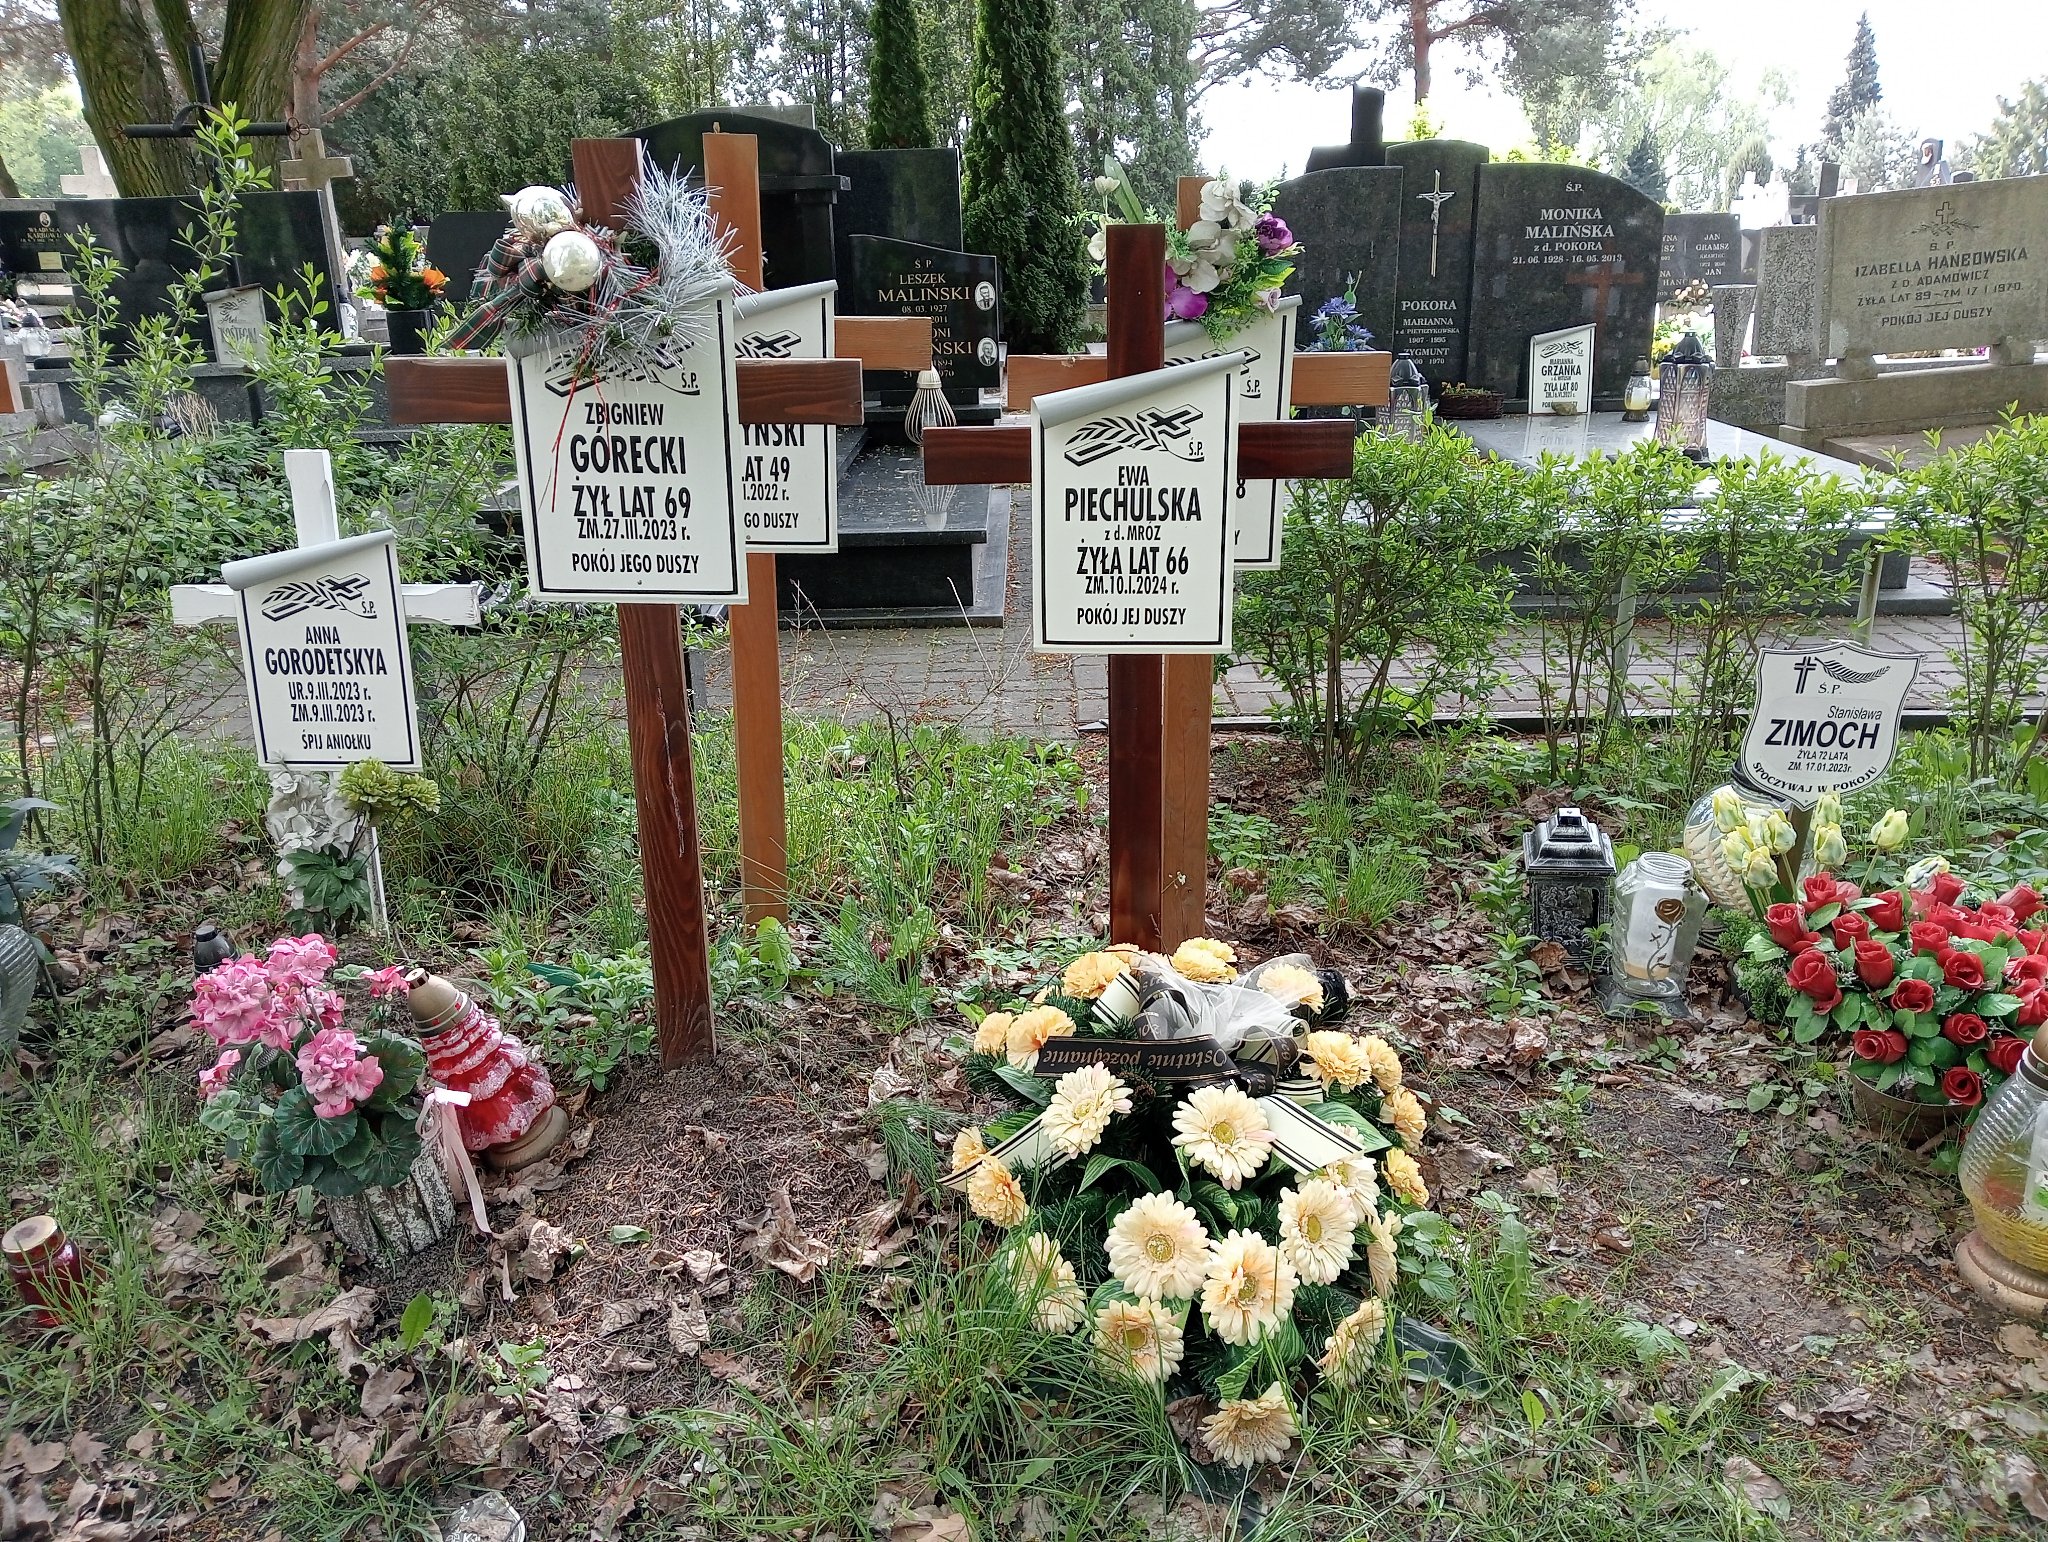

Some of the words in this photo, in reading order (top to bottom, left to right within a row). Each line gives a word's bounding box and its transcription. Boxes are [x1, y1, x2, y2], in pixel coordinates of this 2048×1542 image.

[1566, 182, 1583, 192] Ś.P.
[1540, 207, 1603, 220] MONIKA
[1525, 222, 1615, 239] MALIŃSKA
[1542, 243, 1552, 252] d.
[1555, 242, 1603, 251] POKORA
[1661, 244, 1675, 252] SZ
[1695, 243, 1730, 251] GRAMSZ
[1512, 256, 1525, 264] 21.
[1601, 253, 1622, 262] 2013
[1705, 268, 1722, 276] JAN
[1856, 260, 1921, 277] IZABELLA
[900, 273, 946, 284] LESZEK
[1917, 270, 1989, 287] ADAMOWICZ
[878, 283, 970, 302] MALIŃSKI
[1892, 293, 1911, 303] LAT
[1916, 291, 1932, 300] 89
[930, 304, 948, 313] 1927
[1401, 300, 1457, 311] POKORA
[1403, 317, 1454, 326] MARIANNA
[1927, 312, 1949, 323] JEJ
[1954, 307, 1992, 320] DUSZY
[1403, 348, 1450, 356] ZYGMUNT
[681, 367, 699, 389] Ś.P.
[1541, 365, 1581, 376] GRZANKA
[1246, 376, 1261, 393] Ś.P.
[1560, 382, 1569, 391] LAT
[1571, 382, 1579, 391] 80
[585, 403, 664, 426] ZBIGNIEW
[570, 426, 687, 475] GÓRECKI
[1188, 437, 1204, 456] Ś.P.
[742, 456, 763, 482] AT
[770, 456, 790, 482] 49
[1118, 466, 1150, 486] EWA
[572, 475, 614, 517] ŻYŁ
[619, 486, 655, 518] LAT
[664, 486, 691, 519] 69
[782, 488, 790, 501] r.
[1065, 488, 1202, 522] PIECHULSKA
[577, 518, 677, 540] ZM.27.III.2023
[681, 526, 691, 540] r.
[763, 512, 799, 529] DUSZY
[1105, 530, 1111, 541] z
[1127, 521, 1161, 541] MRÓZ
[572, 548, 615, 572] POKÓJ
[620, 554, 652, 573] JEGO
[656, 554, 699, 574] DUSZY
[1076, 538, 1123, 575] ŻYŁA
[1129, 547, 1160, 575] LAT
[1166, 546, 1189, 575] 66
[1085, 576, 1167, 595] ZM.10.I.2024
[1171, 581, 1179, 595] r.
[361, 597, 376, 614] Ś.P.
[1077, 603, 1118, 625] POKÓJ
[1122, 608, 1140, 625] JEJ
[1144, 608, 1186, 625] DUSZY
[305, 626, 341, 645] ANNA
[265, 648, 388, 676] GORODETSKYA
[288, 682, 361, 701] UR.9.III.2023
[363, 686, 372, 701] r.
[1818, 682, 1842, 694] Ś.P.
[291, 704, 365, 723] ZM.9.III.2023
[367, 708, 376, 723] r.
[1827, 705, 1883, 720] Stanisława
[302, 730, 322, 750] ŚPIJ
[326, 734, 372, 750] ANIOŁKU
[1764, 719, 1881, 750] ZIMOCH
[1797, 748, 1817, 760] ŻYŁA
[1819, 751, 1828, 760] 72
[1828, 751, 1849, 761] LATA
[1788, 761, 1803, 771] ZM.
[1805, 762, 1853, 773] 17.01.2023r.
[1753, 762, 1813, 793] SPOCZYWAJ
[1817, 785, 1828, 793] W
[1832, 766, 1878, 792] POKOJU
[1149, 1049, 1227, 1068] Ostatnie
